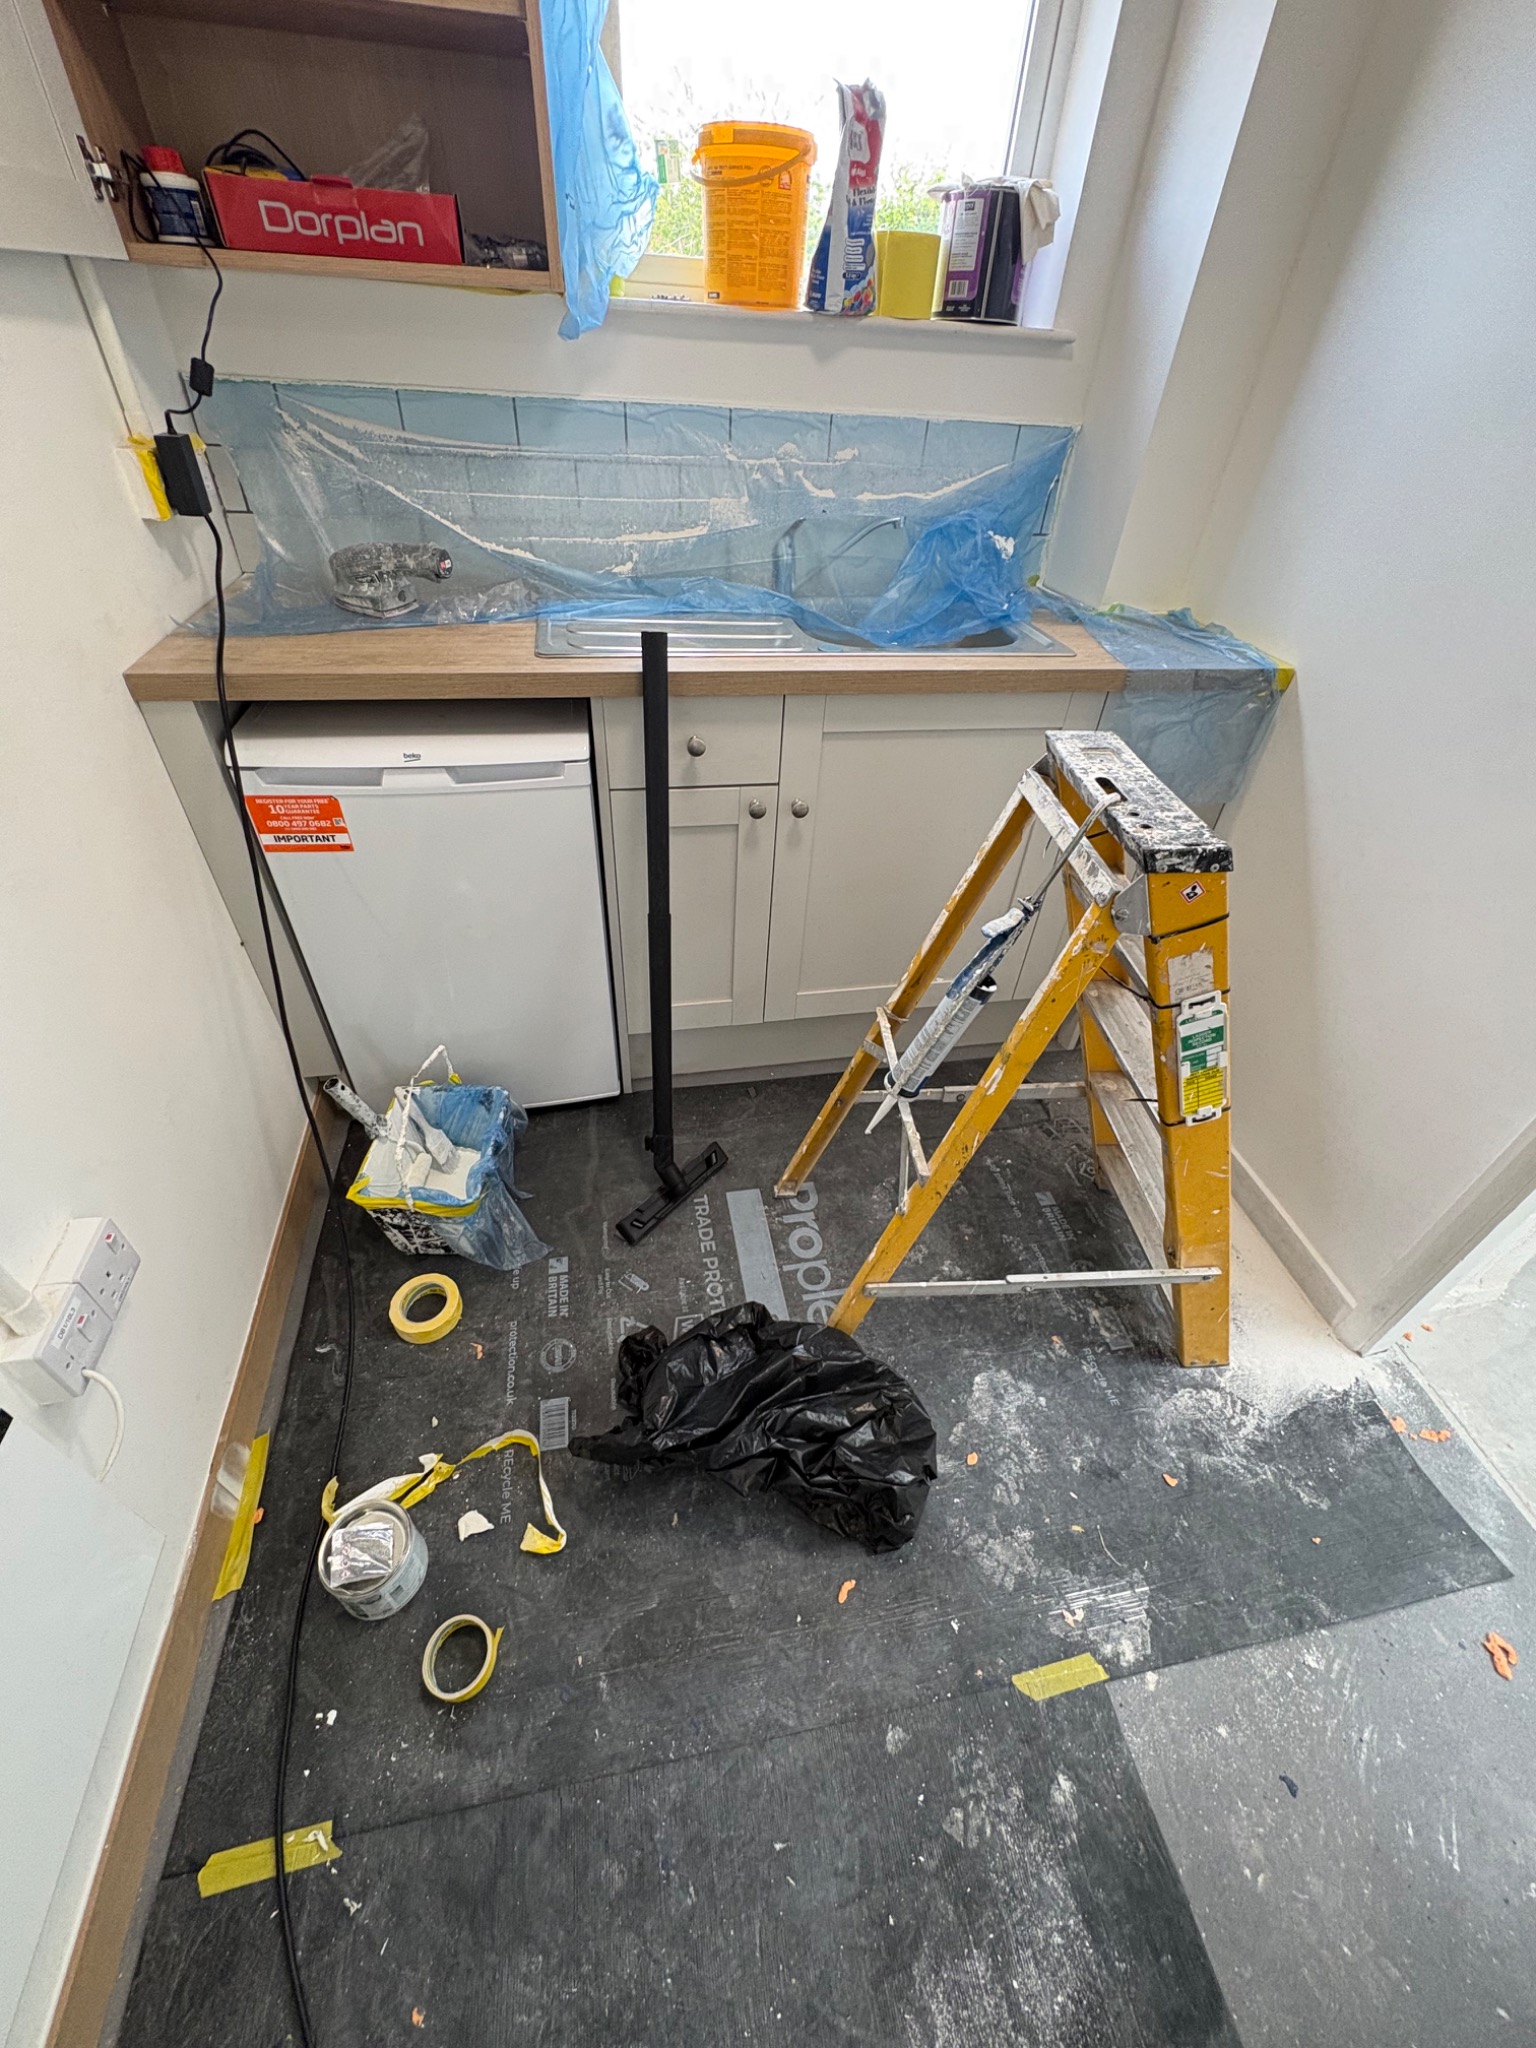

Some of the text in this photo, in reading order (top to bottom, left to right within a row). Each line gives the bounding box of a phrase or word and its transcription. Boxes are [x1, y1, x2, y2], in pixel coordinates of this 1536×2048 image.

[258, 200, 424, 247] Dorplan
[269, 805, 284, 814] 10
[693, 1194, 716, 1252] TRADE
[1042, 1207, 1067, 1242] BRITAIN
[1052, 1205, 1070, 1231] MADE
[782, 1181, 845, 1322] Prople
[511, 1278, 519, 1289] up
[548, 1276, 557, 1317] BRITAIN
[560, 1275, 568, 1303] MADE
[506, 1321, 518, 1406] protection.co.uk
[1106, 1388, 1120, 1408] ME
[500, 1450, 514, 1524] REcycle ME
